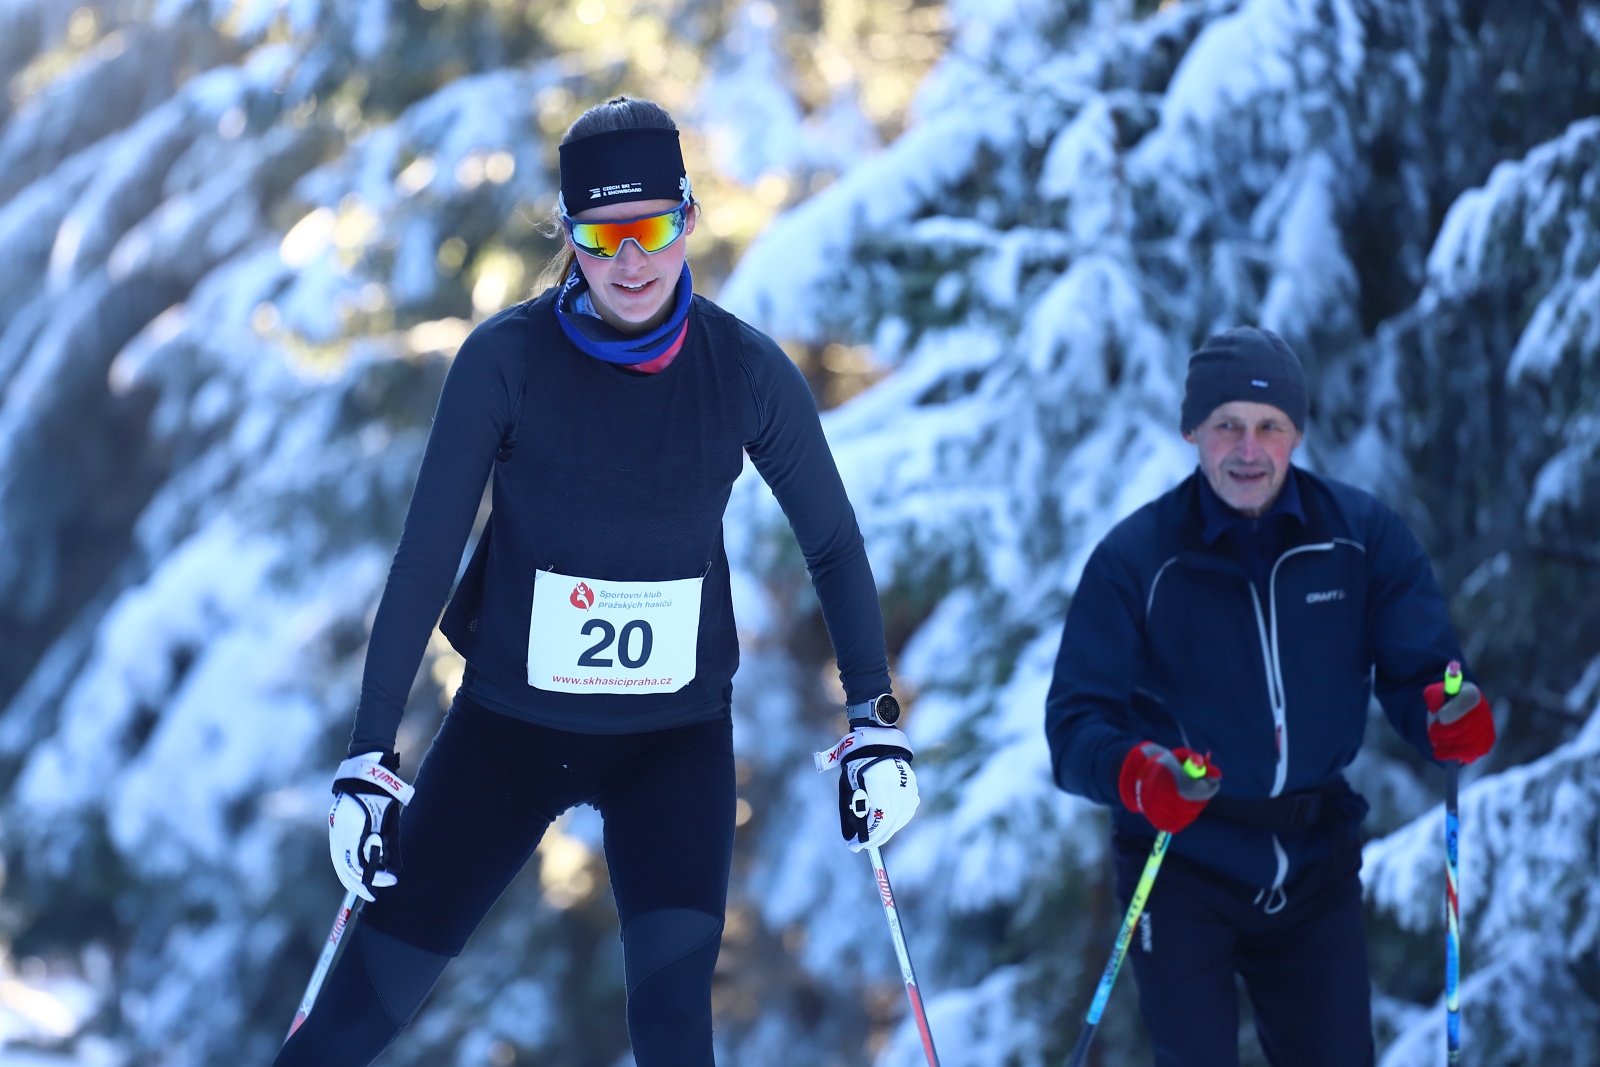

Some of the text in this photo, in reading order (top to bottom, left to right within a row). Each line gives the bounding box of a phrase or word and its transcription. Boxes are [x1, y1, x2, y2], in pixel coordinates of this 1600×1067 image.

[607, 187, 643, 196] SNOWBOARD
[599, 590, 662, 600] Sportovní klub
[597, 599, 673, 611] pražských hasičů
[577, 618, 654, 669] 20
[552, 675, 673, 687] www.skhasicipraha.cz
